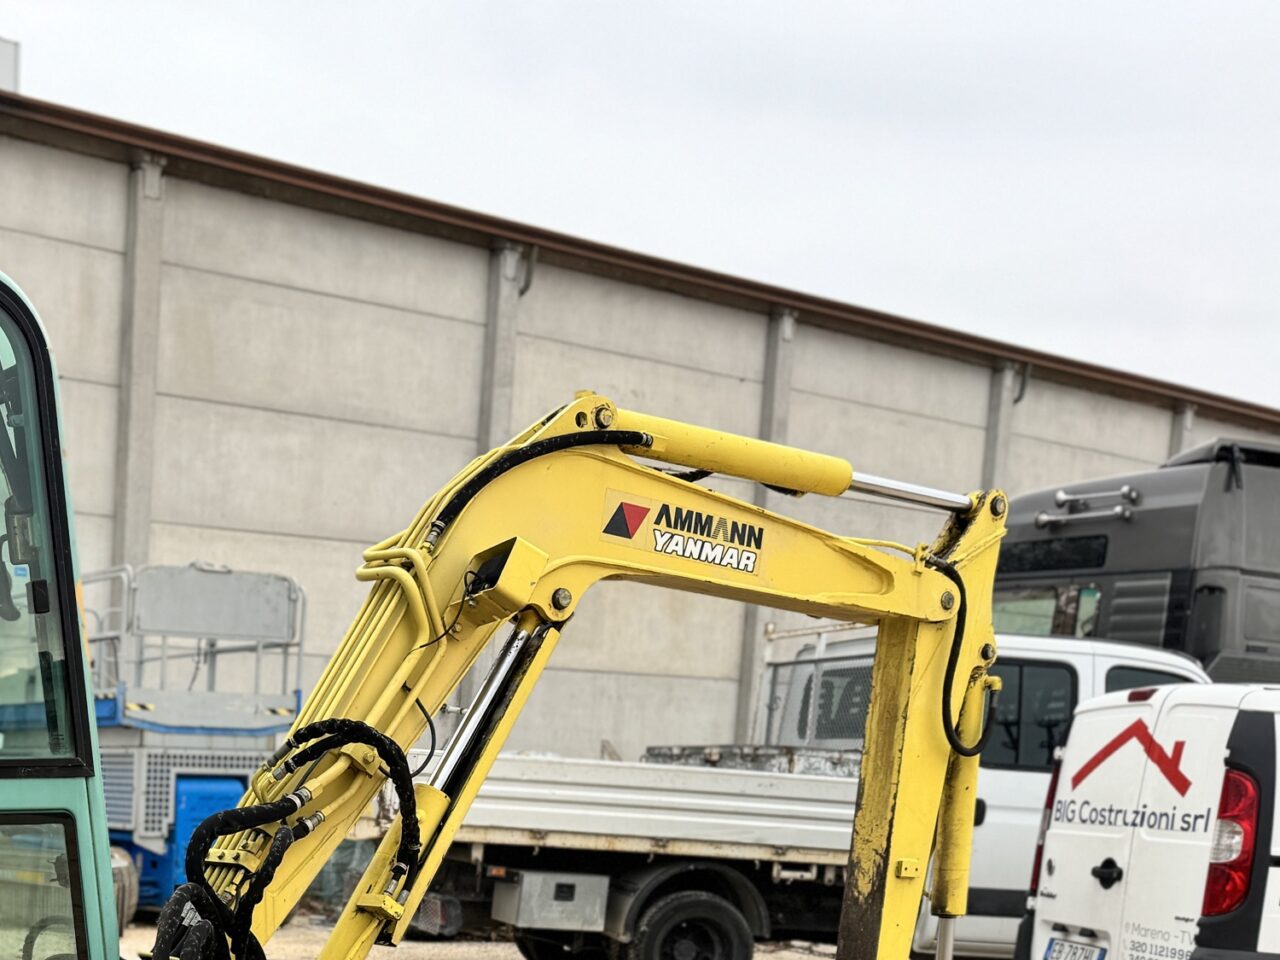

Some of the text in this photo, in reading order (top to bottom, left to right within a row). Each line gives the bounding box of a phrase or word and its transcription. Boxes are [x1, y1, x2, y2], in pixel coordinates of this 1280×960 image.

[653, 503, 764, 550] AMMANN
[653, 528, 757, 573] YANMAR
[1054, 800, 1211, 832] BIG Costruzioni srl
[1129, 940, 1147, 953] 320
[1131, 922, 1170, 942] Mareno
